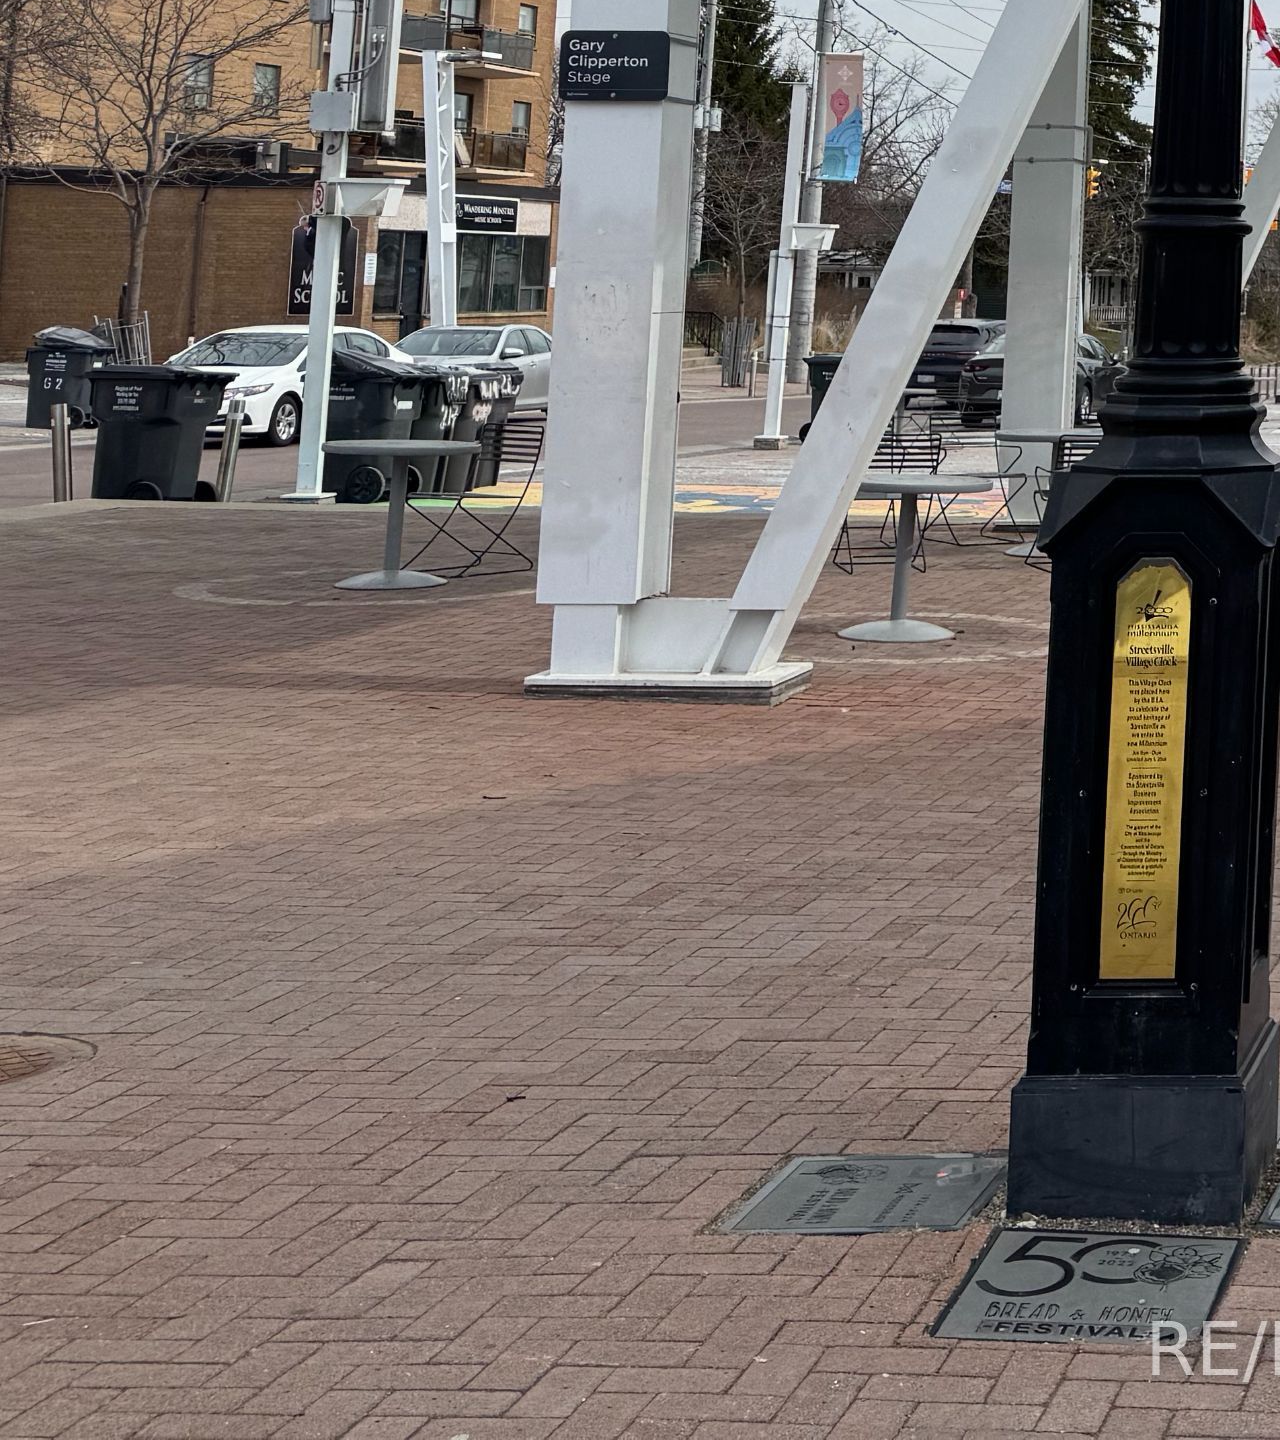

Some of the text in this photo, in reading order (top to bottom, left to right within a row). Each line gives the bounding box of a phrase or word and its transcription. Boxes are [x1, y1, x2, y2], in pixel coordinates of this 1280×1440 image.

[569, 39, 605, 53] Gary
[568, 55, 649, 69] Clipperton
[567, 71, 611, 85] Stage
[43, 378, 63, 391] G 2
[1129, 644, 1174, 654] Streetsville
[1126, 656, 1177, 669] Village Clock
[1120, 931, 1157, 939] ONTARIO
[985, 1301, 1174, 1324] BREAD & HONEY
[993, 1322, 1145, 1339] FESTIVAL
